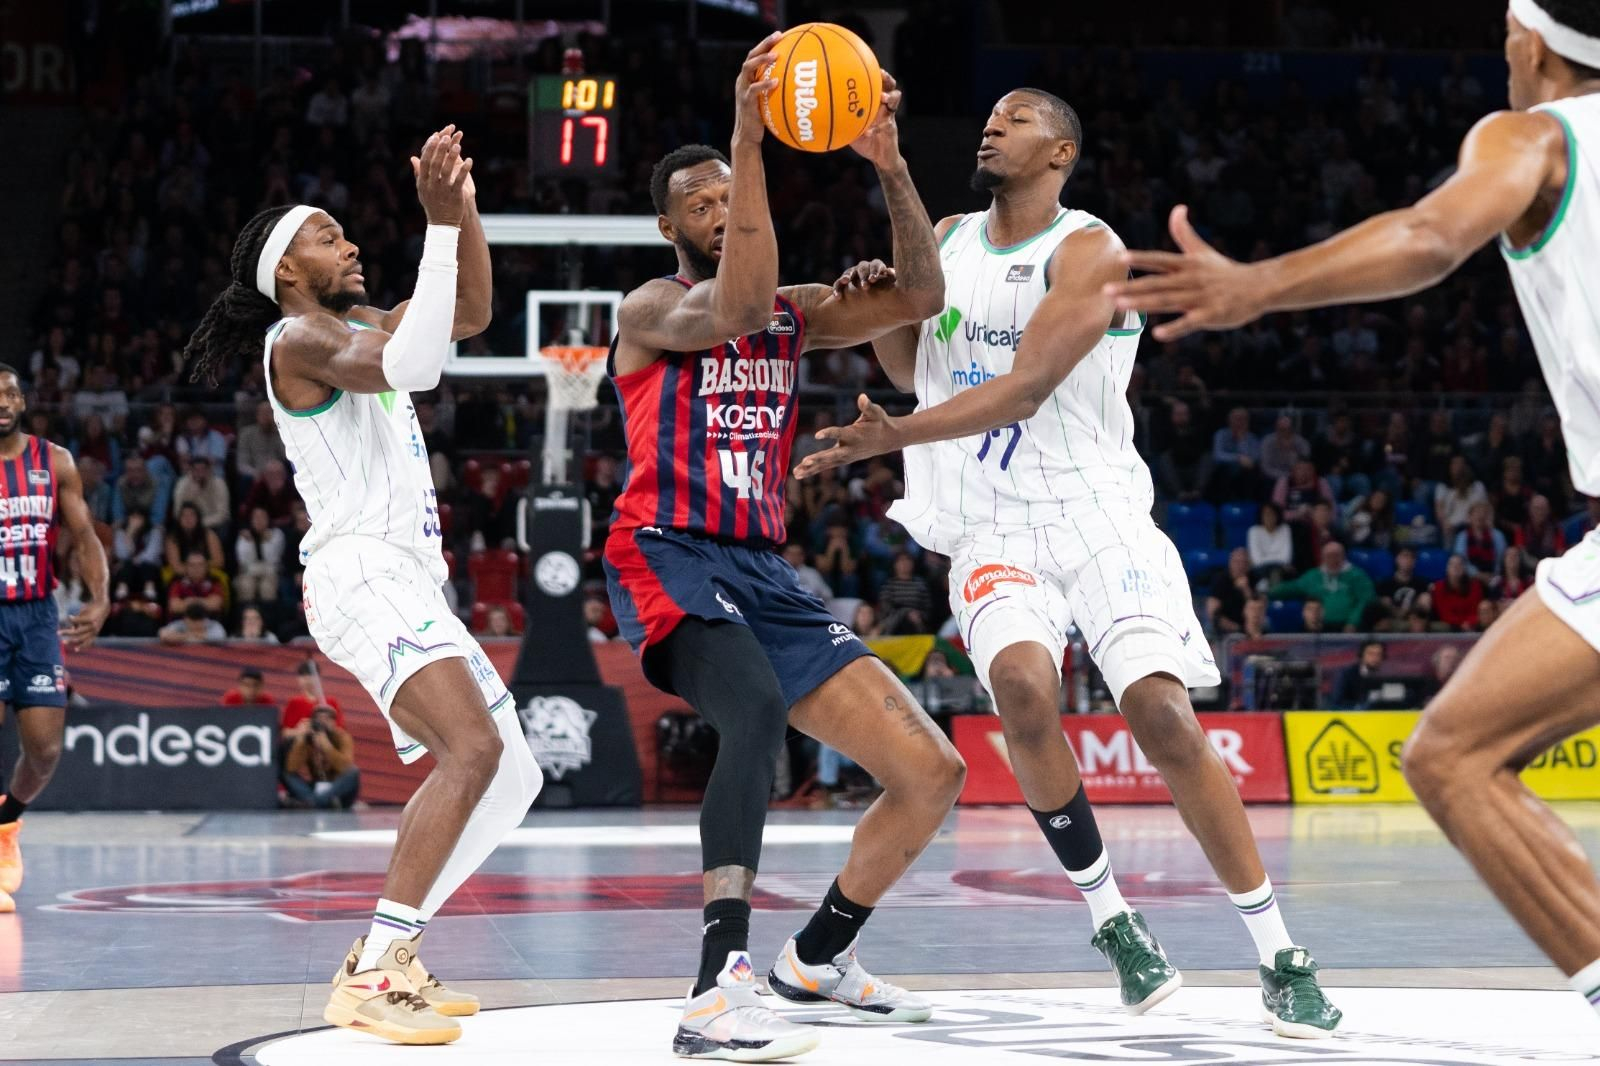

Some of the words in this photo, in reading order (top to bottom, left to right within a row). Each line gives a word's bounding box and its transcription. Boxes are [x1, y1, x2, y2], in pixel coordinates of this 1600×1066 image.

[794, 59, 818, 142] Wilson
[846, 78, 859, 113] acb
[560, 116, 608, 166] 17
[0, 553, 37, 586] 44
[64, 712, 272, 767] ndesa
